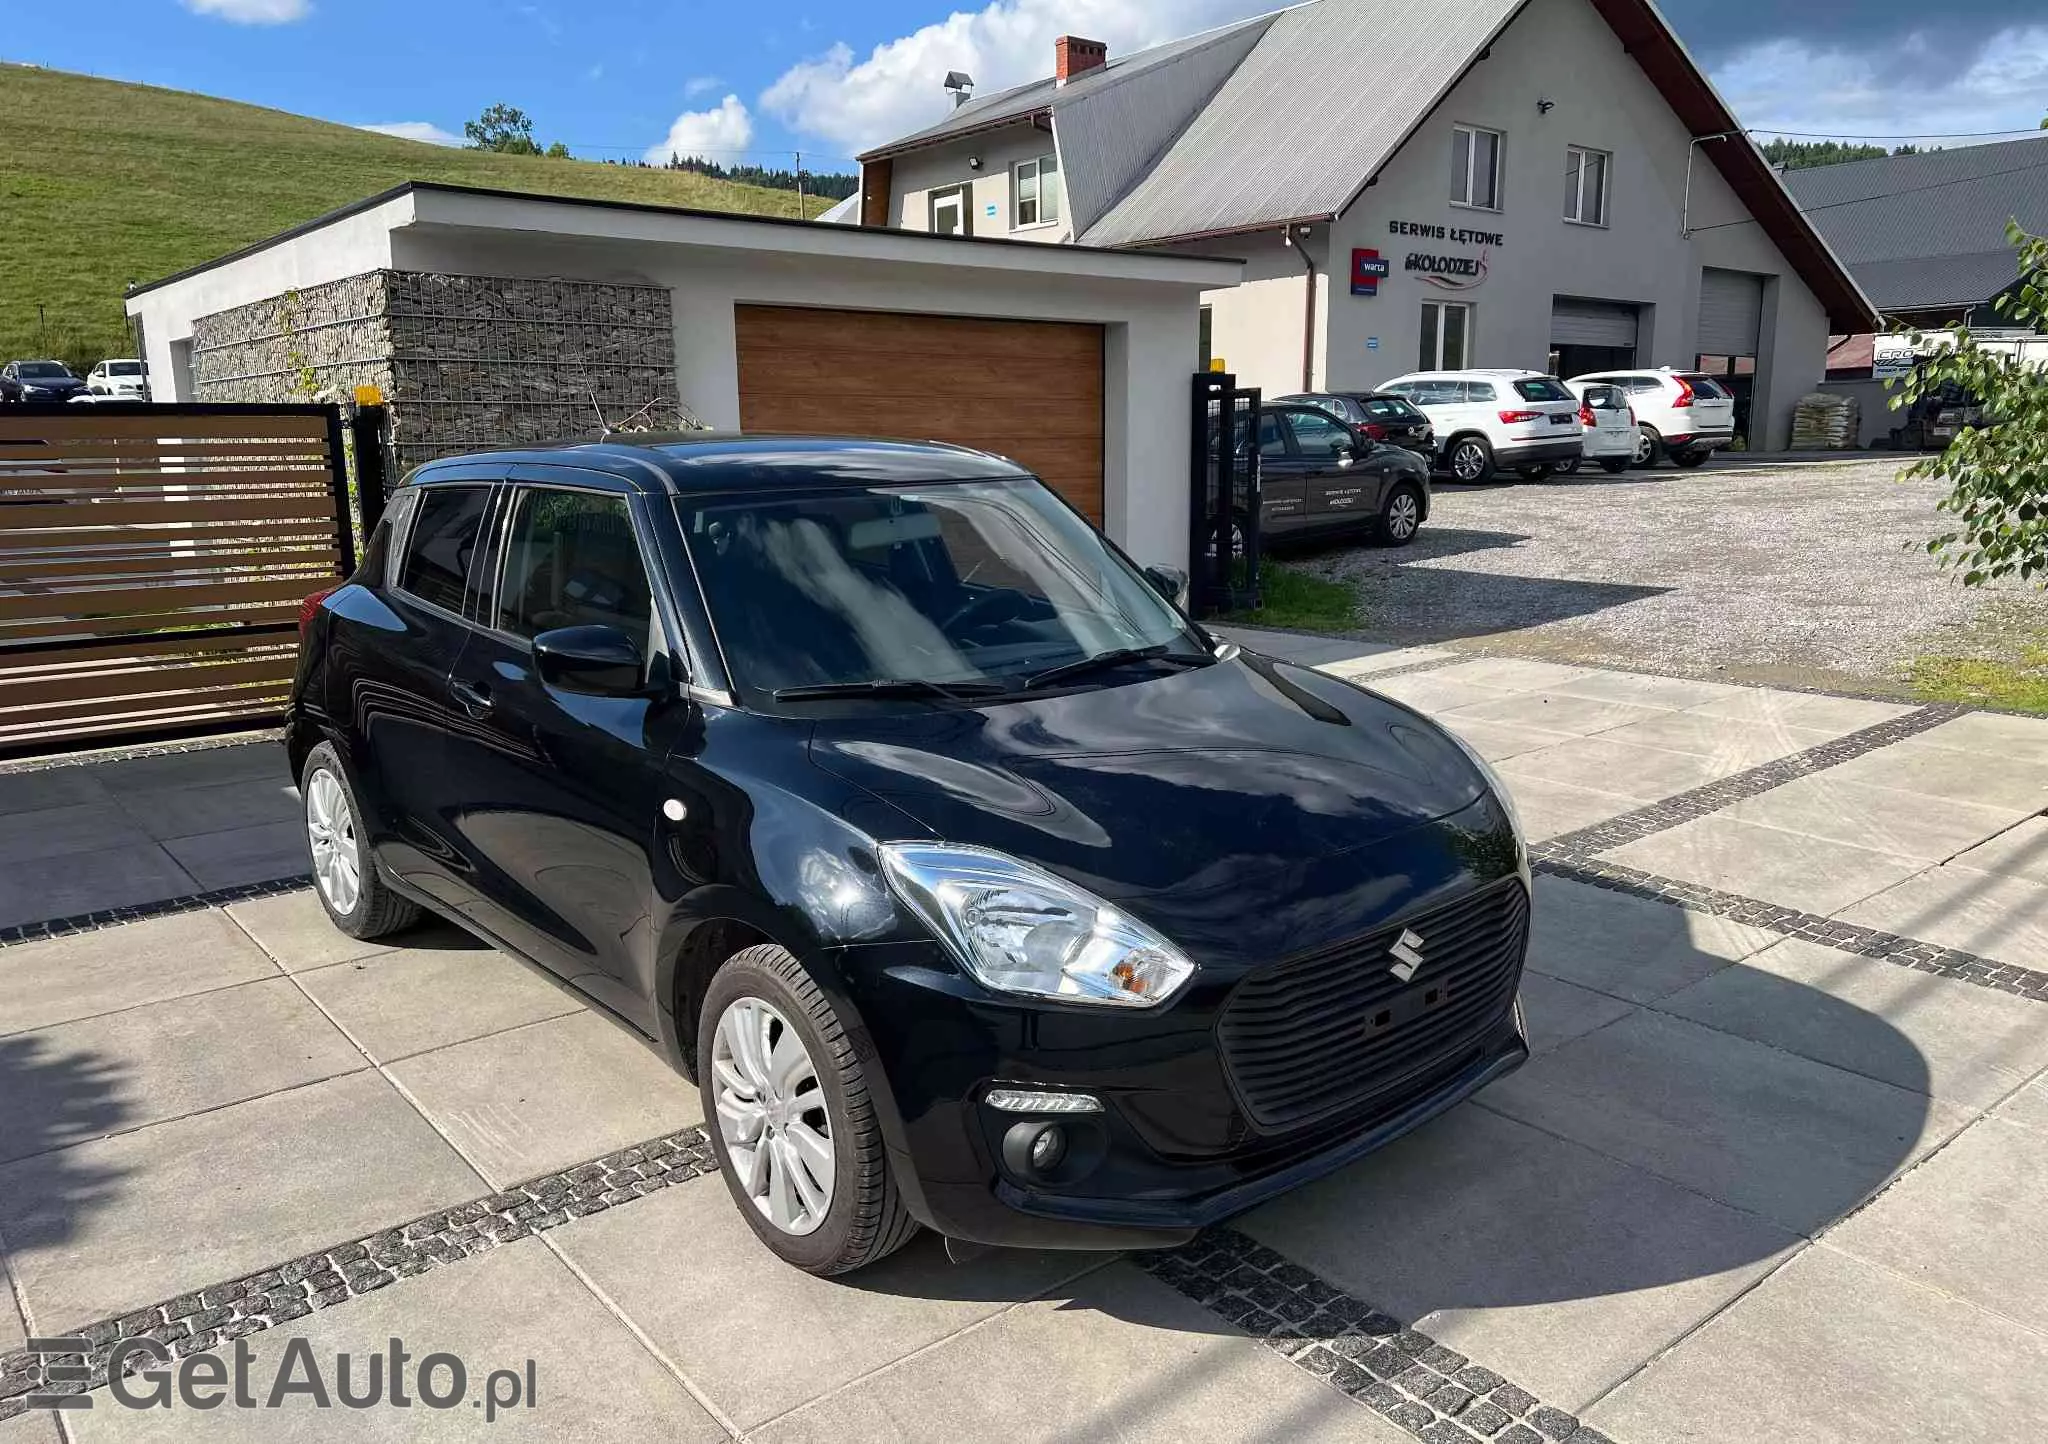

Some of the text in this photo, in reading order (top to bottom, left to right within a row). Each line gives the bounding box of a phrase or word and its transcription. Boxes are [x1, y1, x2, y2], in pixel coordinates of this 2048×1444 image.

[1389, 220, 1504, 247] SERWIS ŁĘTOWE
[1364, 263, 1385, 272] warta
